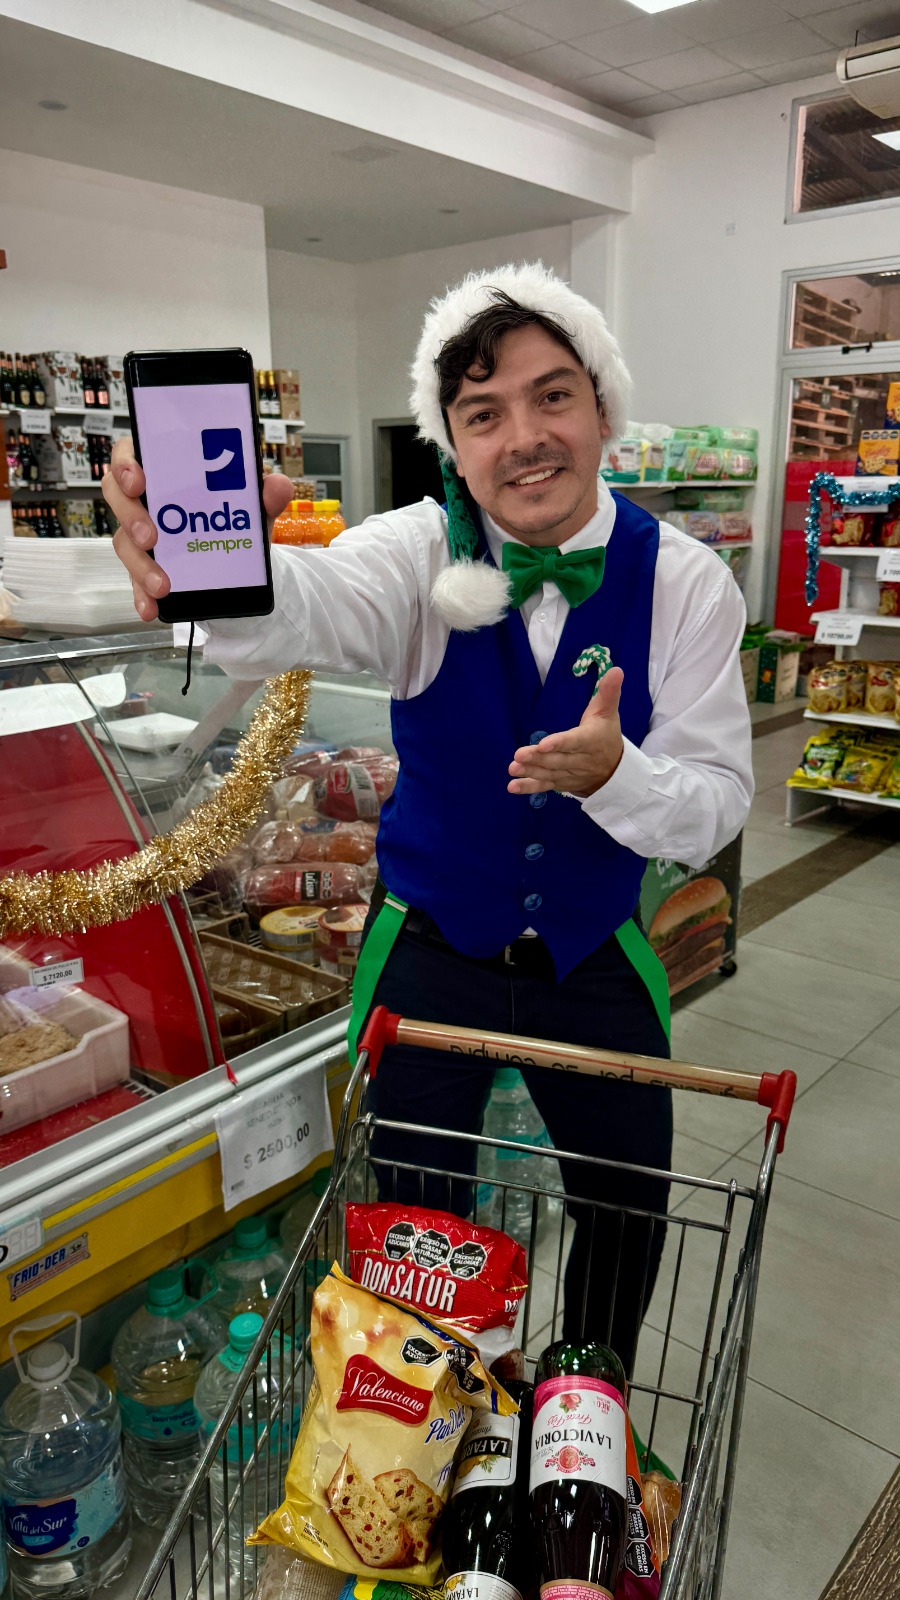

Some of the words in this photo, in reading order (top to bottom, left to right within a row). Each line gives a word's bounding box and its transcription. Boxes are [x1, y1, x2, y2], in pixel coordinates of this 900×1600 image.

[157, 502, 251, 534] Onda
[187, 538, 252, 554] siempre
[48, 969, 72, 980] 7120,00
[243, 1153, 254, 1170] $
[257, 1122, 310, 1164] 2500,00
[388, 1232, 406, 1242] EXCESO
[420, 1235, 440, 1248] EXCESO
[440, 1242, 449, 1251] EN
[421, 1243, 442, 1255] GRASAS
[454, 1252, 474, 1262] EXCESO
[13, 1248, 66, 1288] FRIO-DER
[349, 1367, 425, 1413] Valenciano
[569, 1411, 592, 1425] Fresa
[535, 1428, 595, 1450] VICTORIA
[10, 1515, 28, 1534] Villa
[30, 1526, 40, 1535] del
[41, 1517, 67, 1533] Sur
[643, 1565, 649, 1574] EN
